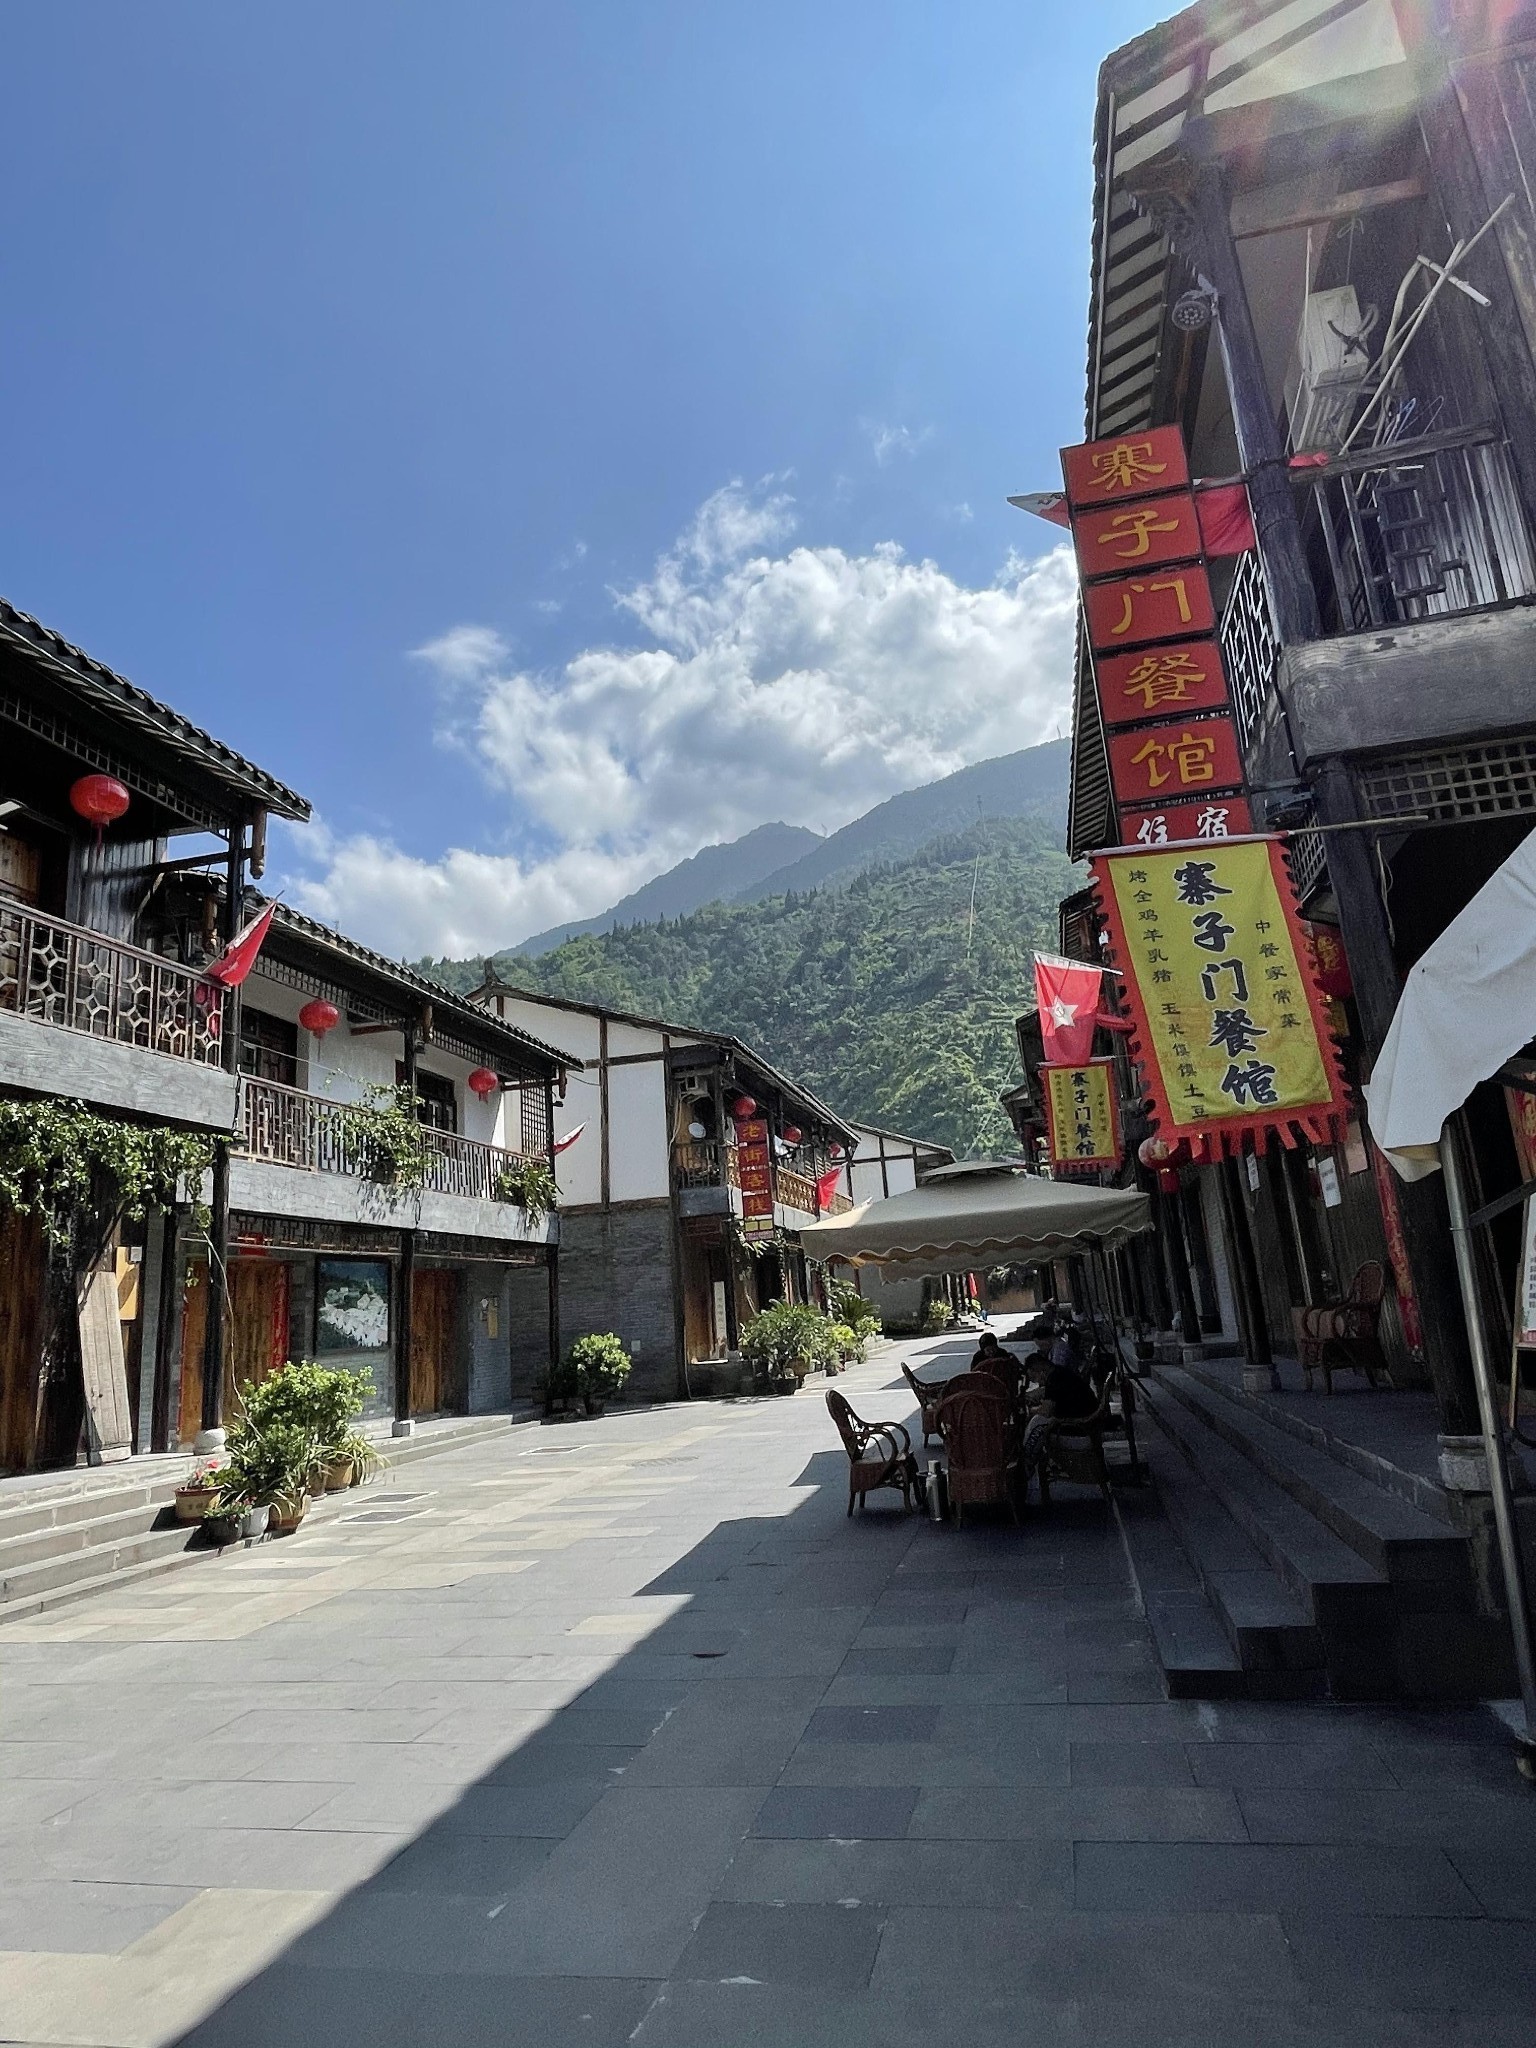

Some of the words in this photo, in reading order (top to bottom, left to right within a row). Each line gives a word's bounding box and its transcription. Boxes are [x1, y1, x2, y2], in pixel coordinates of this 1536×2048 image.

[1088, 443, 1215, 788] 寨子门餐馆
[1137, 806, 1229, 845] 住宿
[1174, 861, 1278, 1105] 寨子门餐馆
[1256, 920, 1301, 1028] 中餐家常菜
